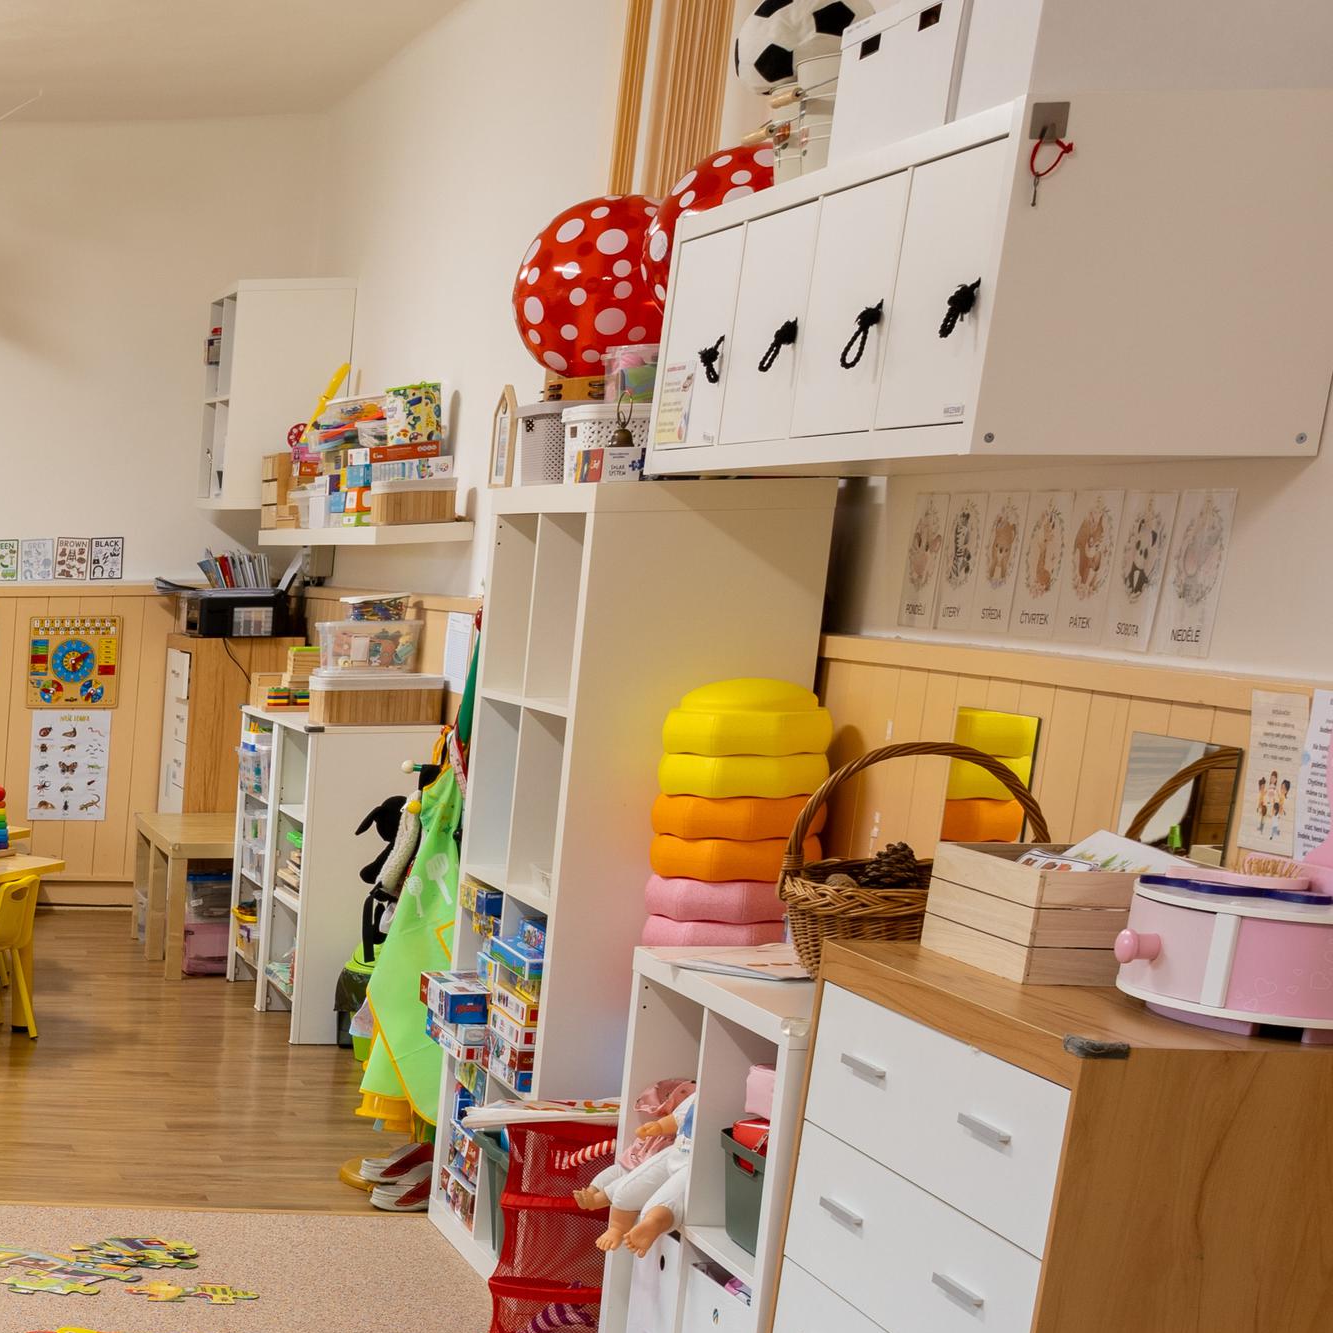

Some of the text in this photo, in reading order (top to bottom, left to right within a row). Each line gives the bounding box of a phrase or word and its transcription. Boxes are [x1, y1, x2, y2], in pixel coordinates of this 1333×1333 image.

[1020, 611, 1049, 624] ČTVRTEK
[1069, 614, 1091, 628] PÁTEK
[1116, 622, 1139, 636] SOBOTA
[1171, 627, 1200, 642] NEDĚLE
